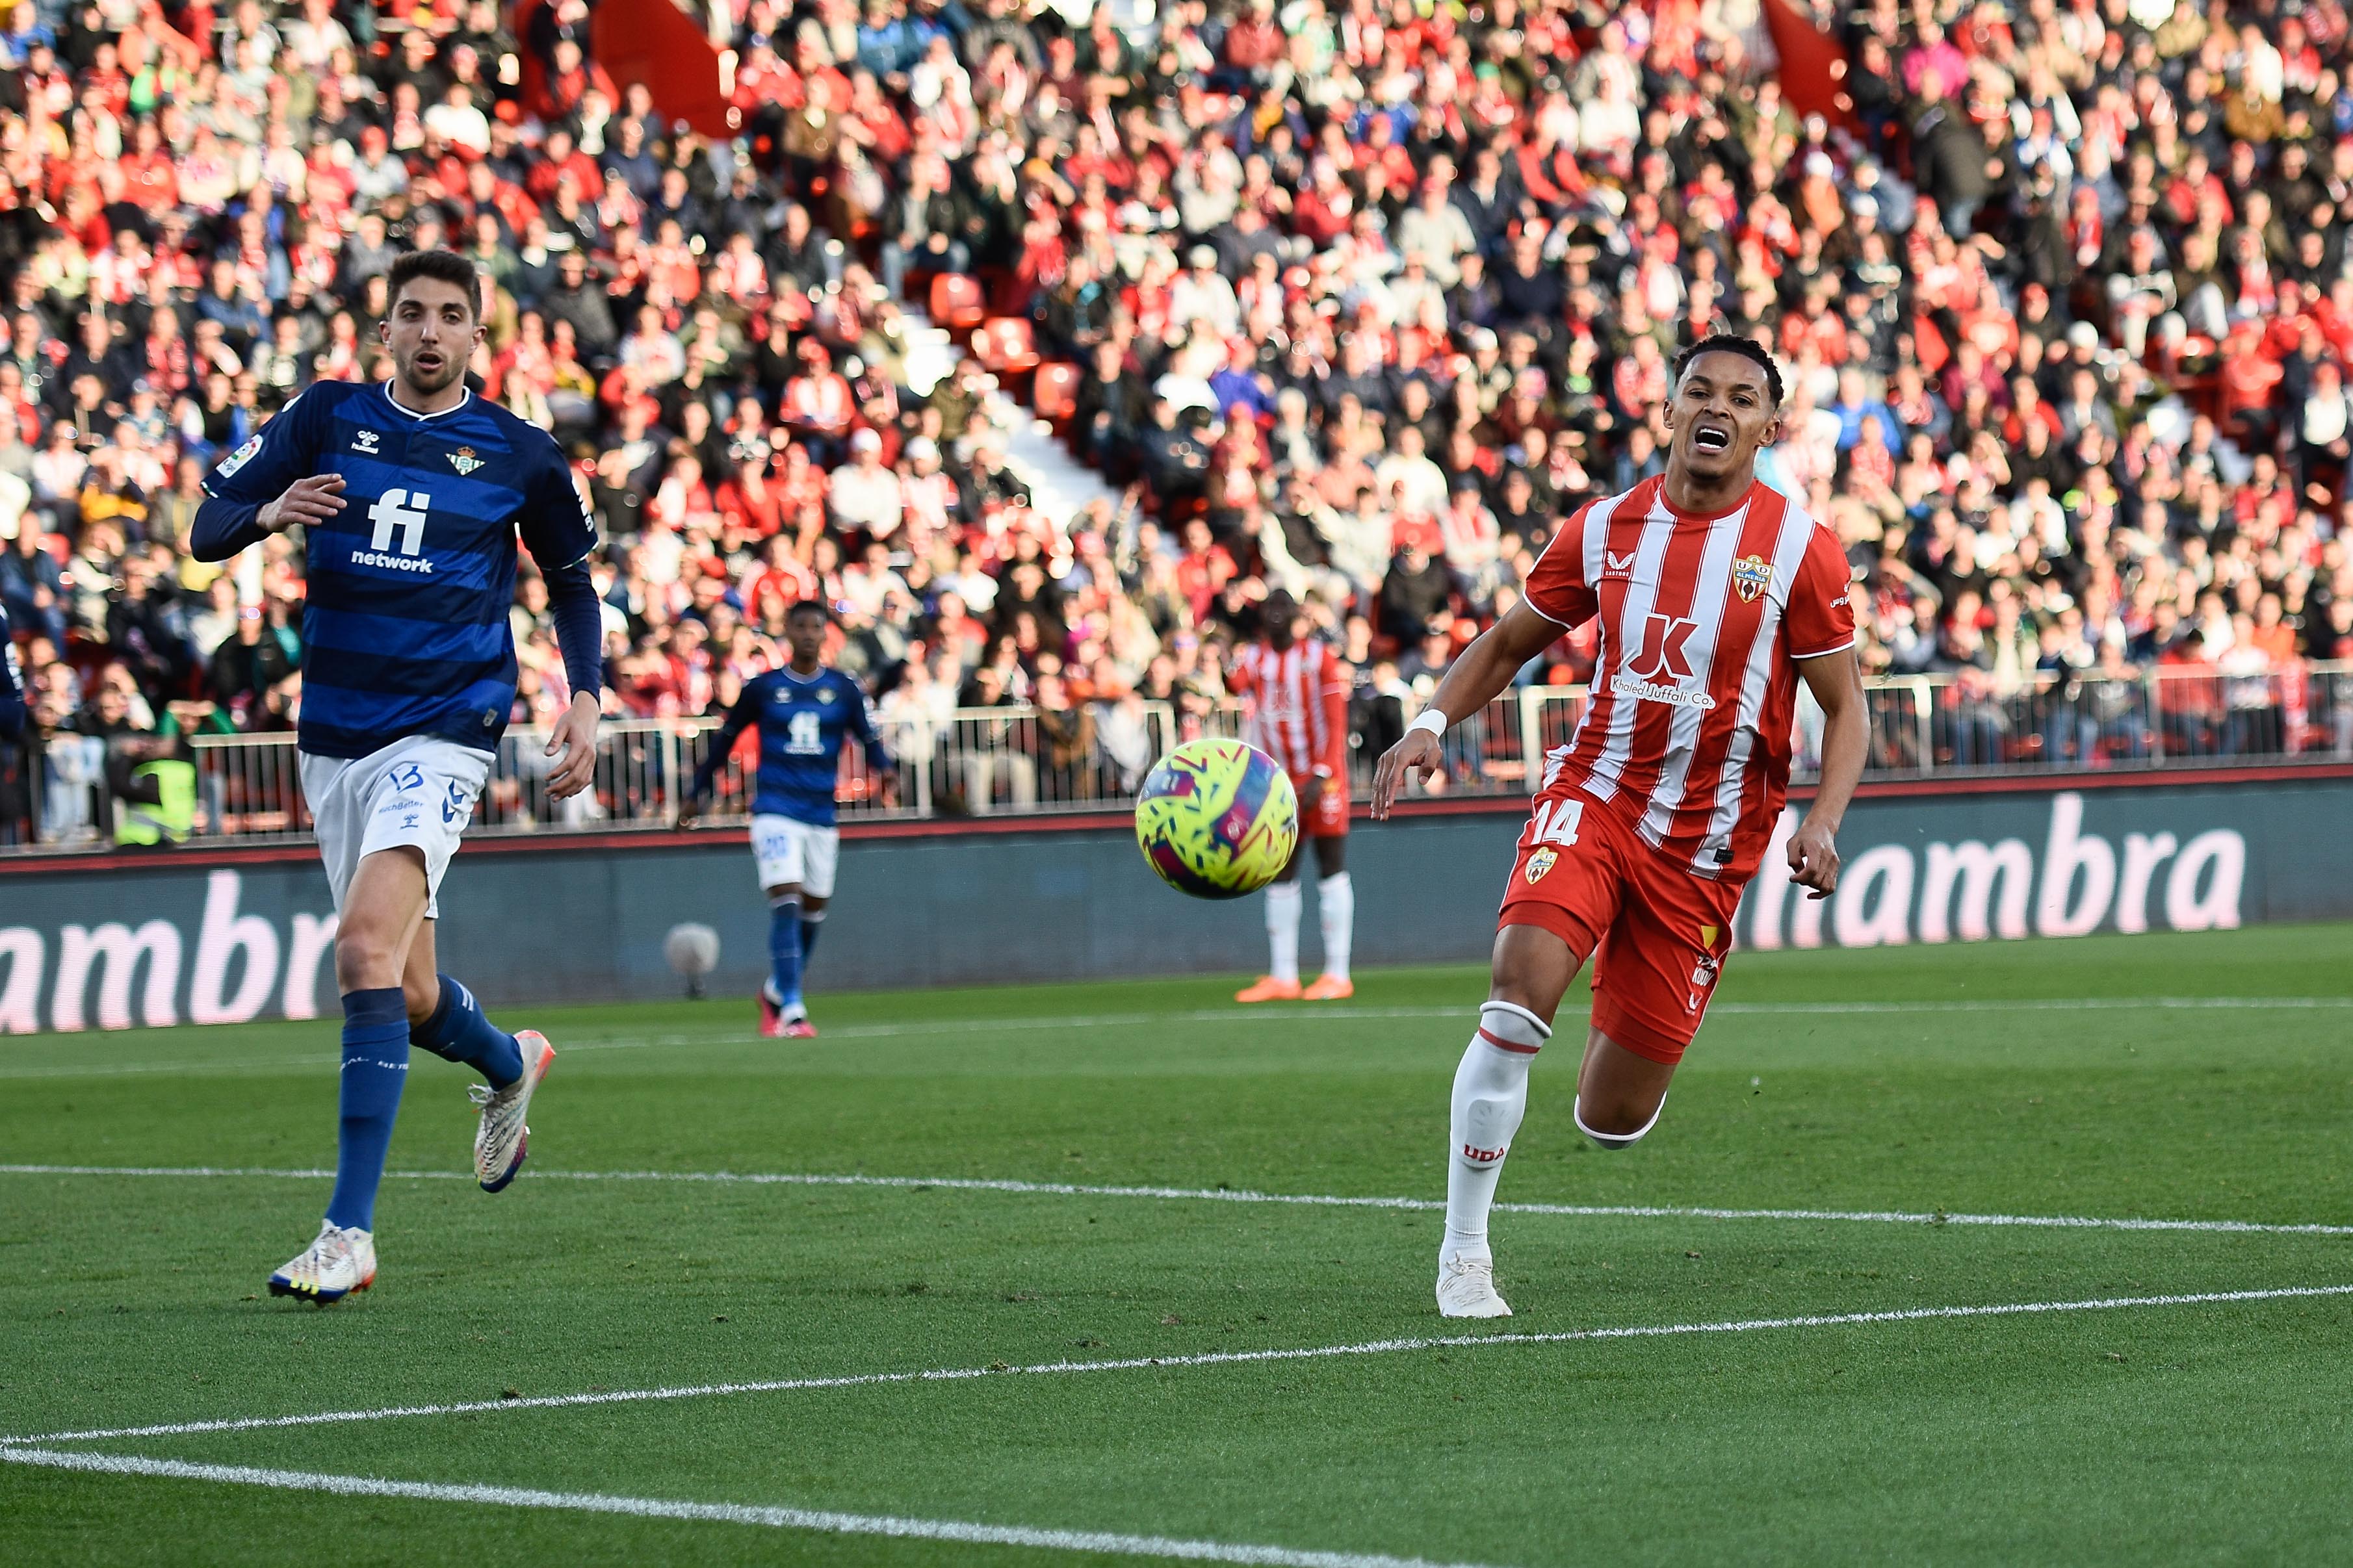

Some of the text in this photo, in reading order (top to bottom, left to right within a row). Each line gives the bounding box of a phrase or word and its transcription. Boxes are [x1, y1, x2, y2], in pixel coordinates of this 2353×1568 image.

[368, 489, 430, 556] fi
[351, 550, 433, 574] network
[1736, 572, 1766, 583] ALMERIA
[1628, 614, 1699, 677] JK
[1613, 678, 1712, 706] Khaled Juffali Co.
[390, 765, 424, 793] 13
[1531, 799, 1584, 847] 14
[1731, 791, 2247, 953] hambra
[1692, 966, 1715, 986] KUDU
[1464, 1144, 1505, 1163] UDA
